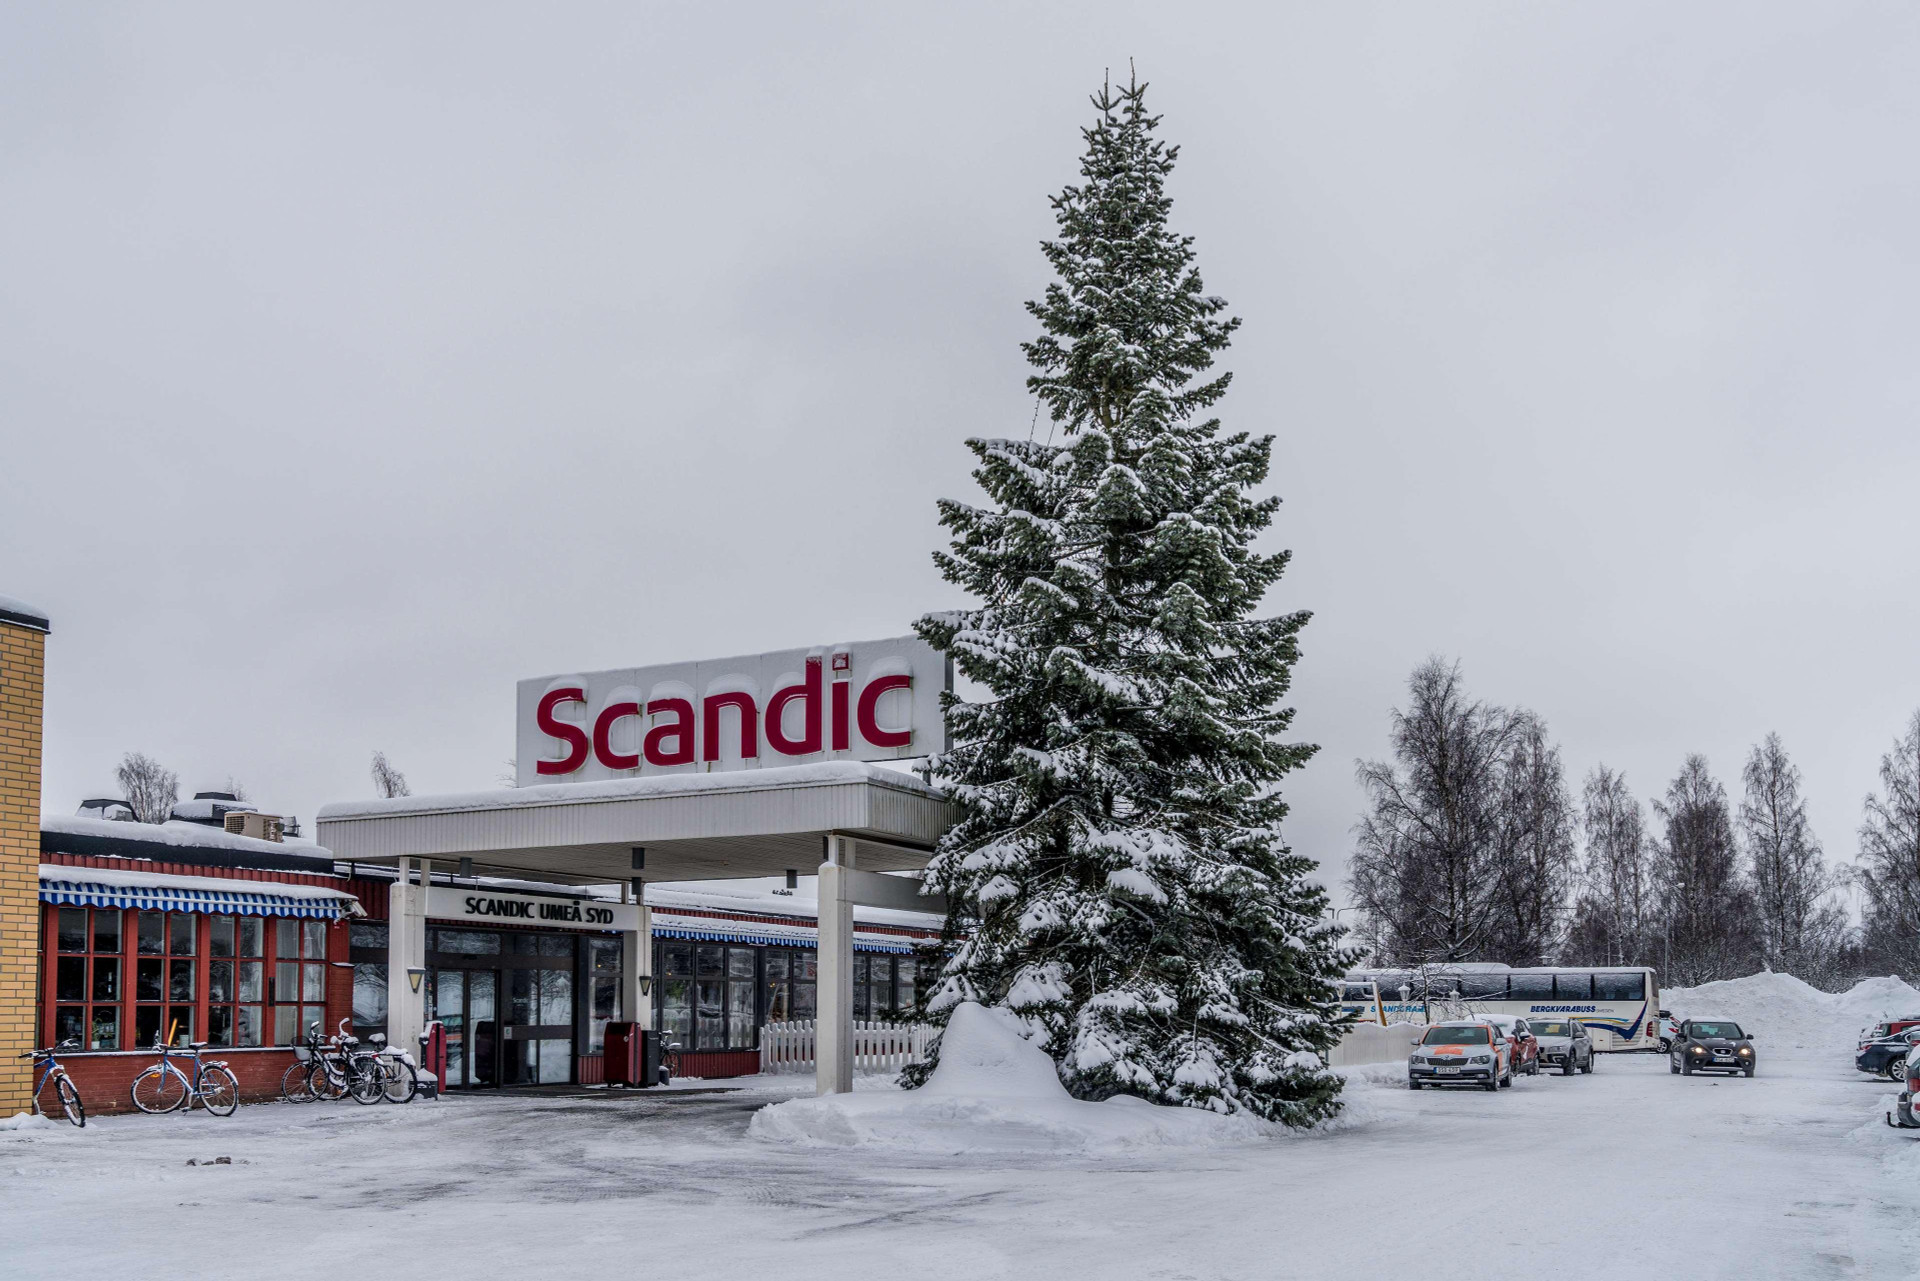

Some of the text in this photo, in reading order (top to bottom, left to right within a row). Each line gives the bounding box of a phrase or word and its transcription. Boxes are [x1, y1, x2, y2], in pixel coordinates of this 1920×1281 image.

[536, 652, 911, 775] Scandic
[465, 896, 614, 925] SCANDIC UMEÅ SYD
[1530, 1005, 1596, 1013] BERGKVARABUSS
